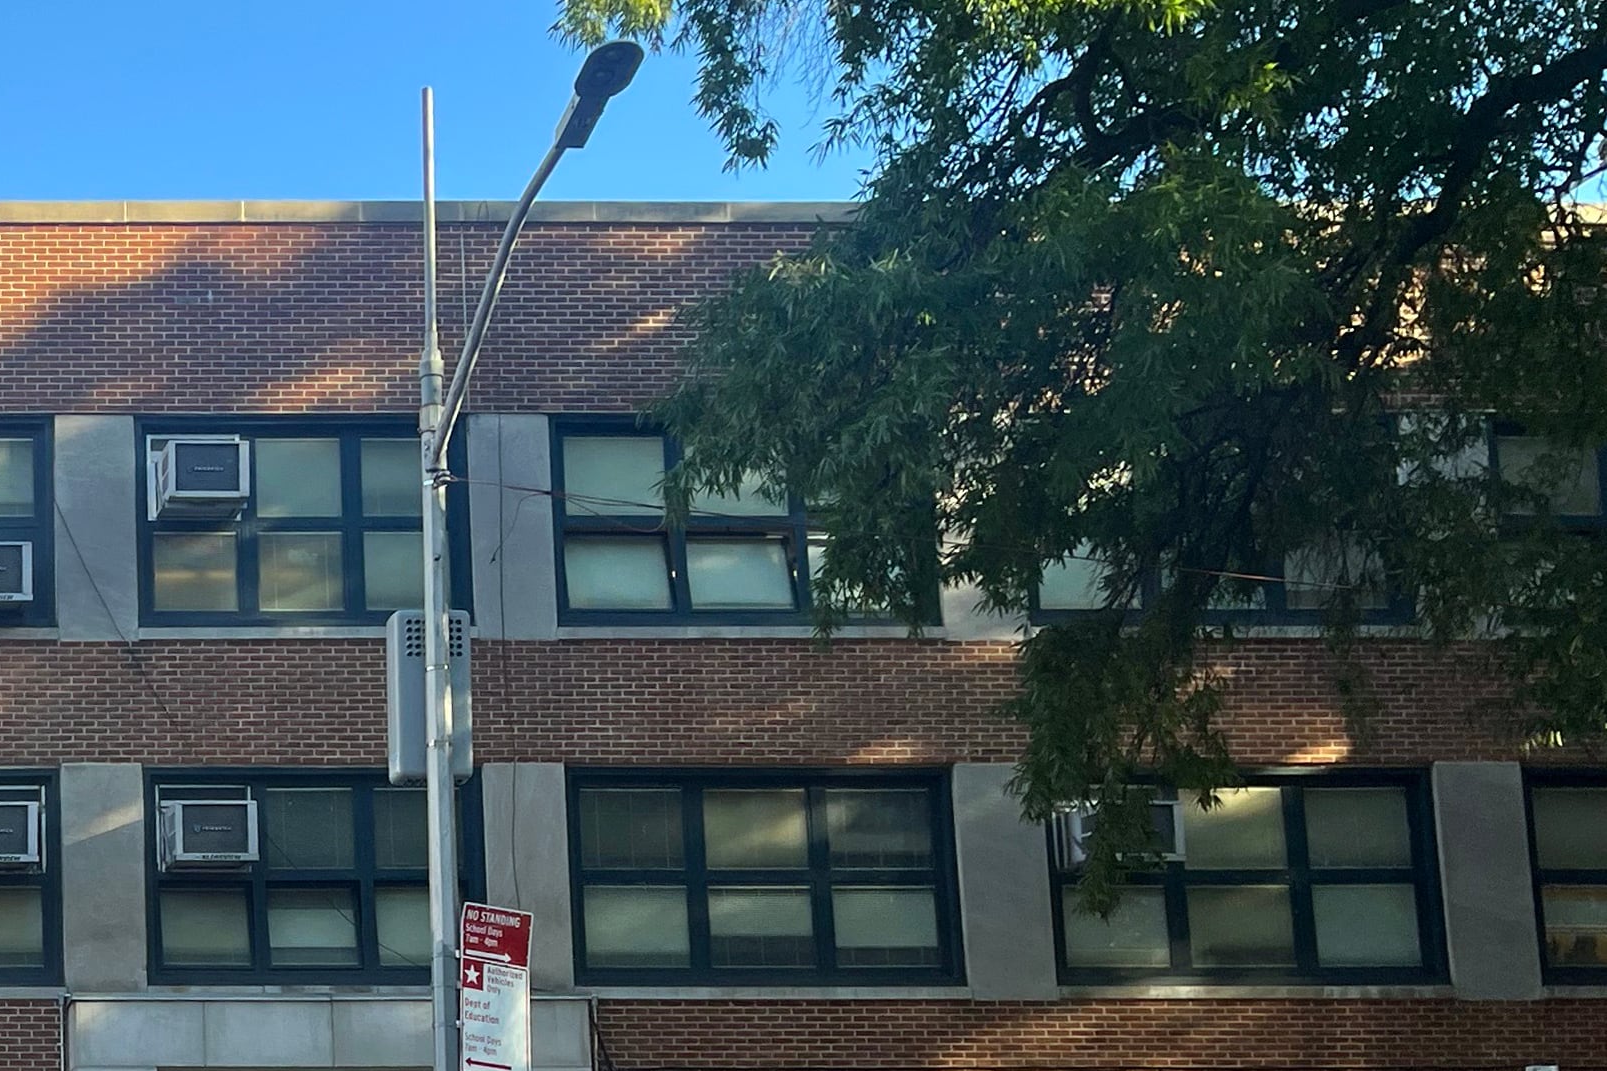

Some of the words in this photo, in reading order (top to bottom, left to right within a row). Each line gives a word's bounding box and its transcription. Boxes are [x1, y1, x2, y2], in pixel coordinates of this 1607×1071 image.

[466, 909, 479, 921] NO
[481, 911, 521, 928] STANDING
[465, 922, 486, 934] School
[488, 925, 503, 938] Days
[465, 933, 479, 944] 7am
[484, 937, 498, 947] 4pm
[487, 966, 523, 980] Authorized
[487, 975, 514, 988] Vehicles
[486, 984, 501, 996] Only
[465, 997, 481, 1009] Dept
[465, 1010, 500, 1025] Education
[465, 1031, 485, 1043] School
[487, 1035, 502, 1047] Days
